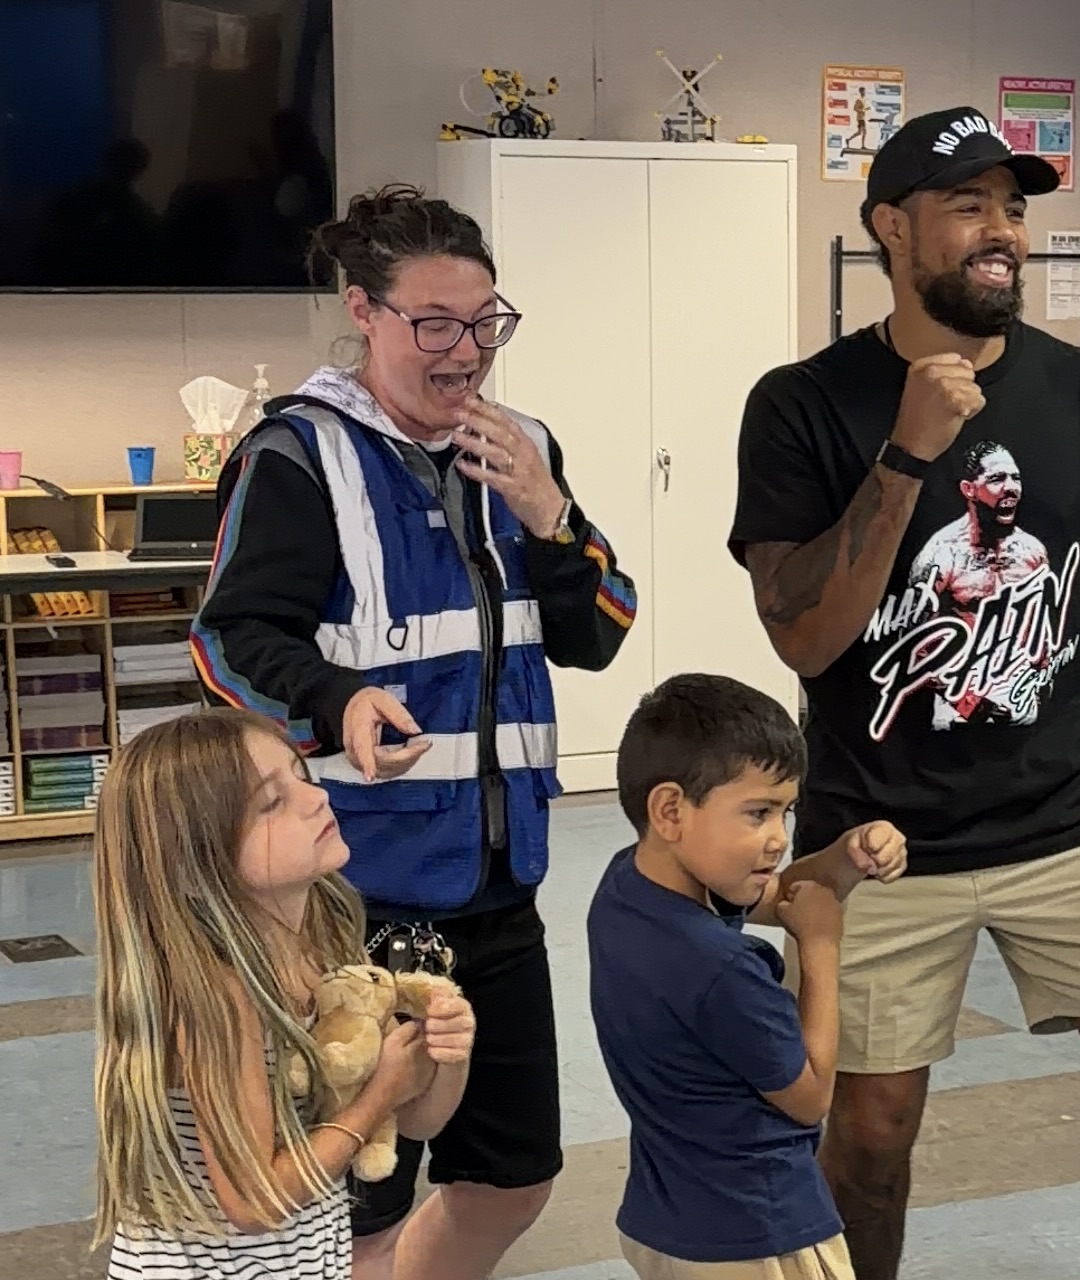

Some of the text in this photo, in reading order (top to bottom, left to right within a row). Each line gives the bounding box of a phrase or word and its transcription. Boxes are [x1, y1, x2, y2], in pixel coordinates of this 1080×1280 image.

[932, 132, 960, 155] NO
[950, 116, 988, 138] BAD
[864, 565, 940, 643] MAX
[869, 542, 1080, 742] PAIN
